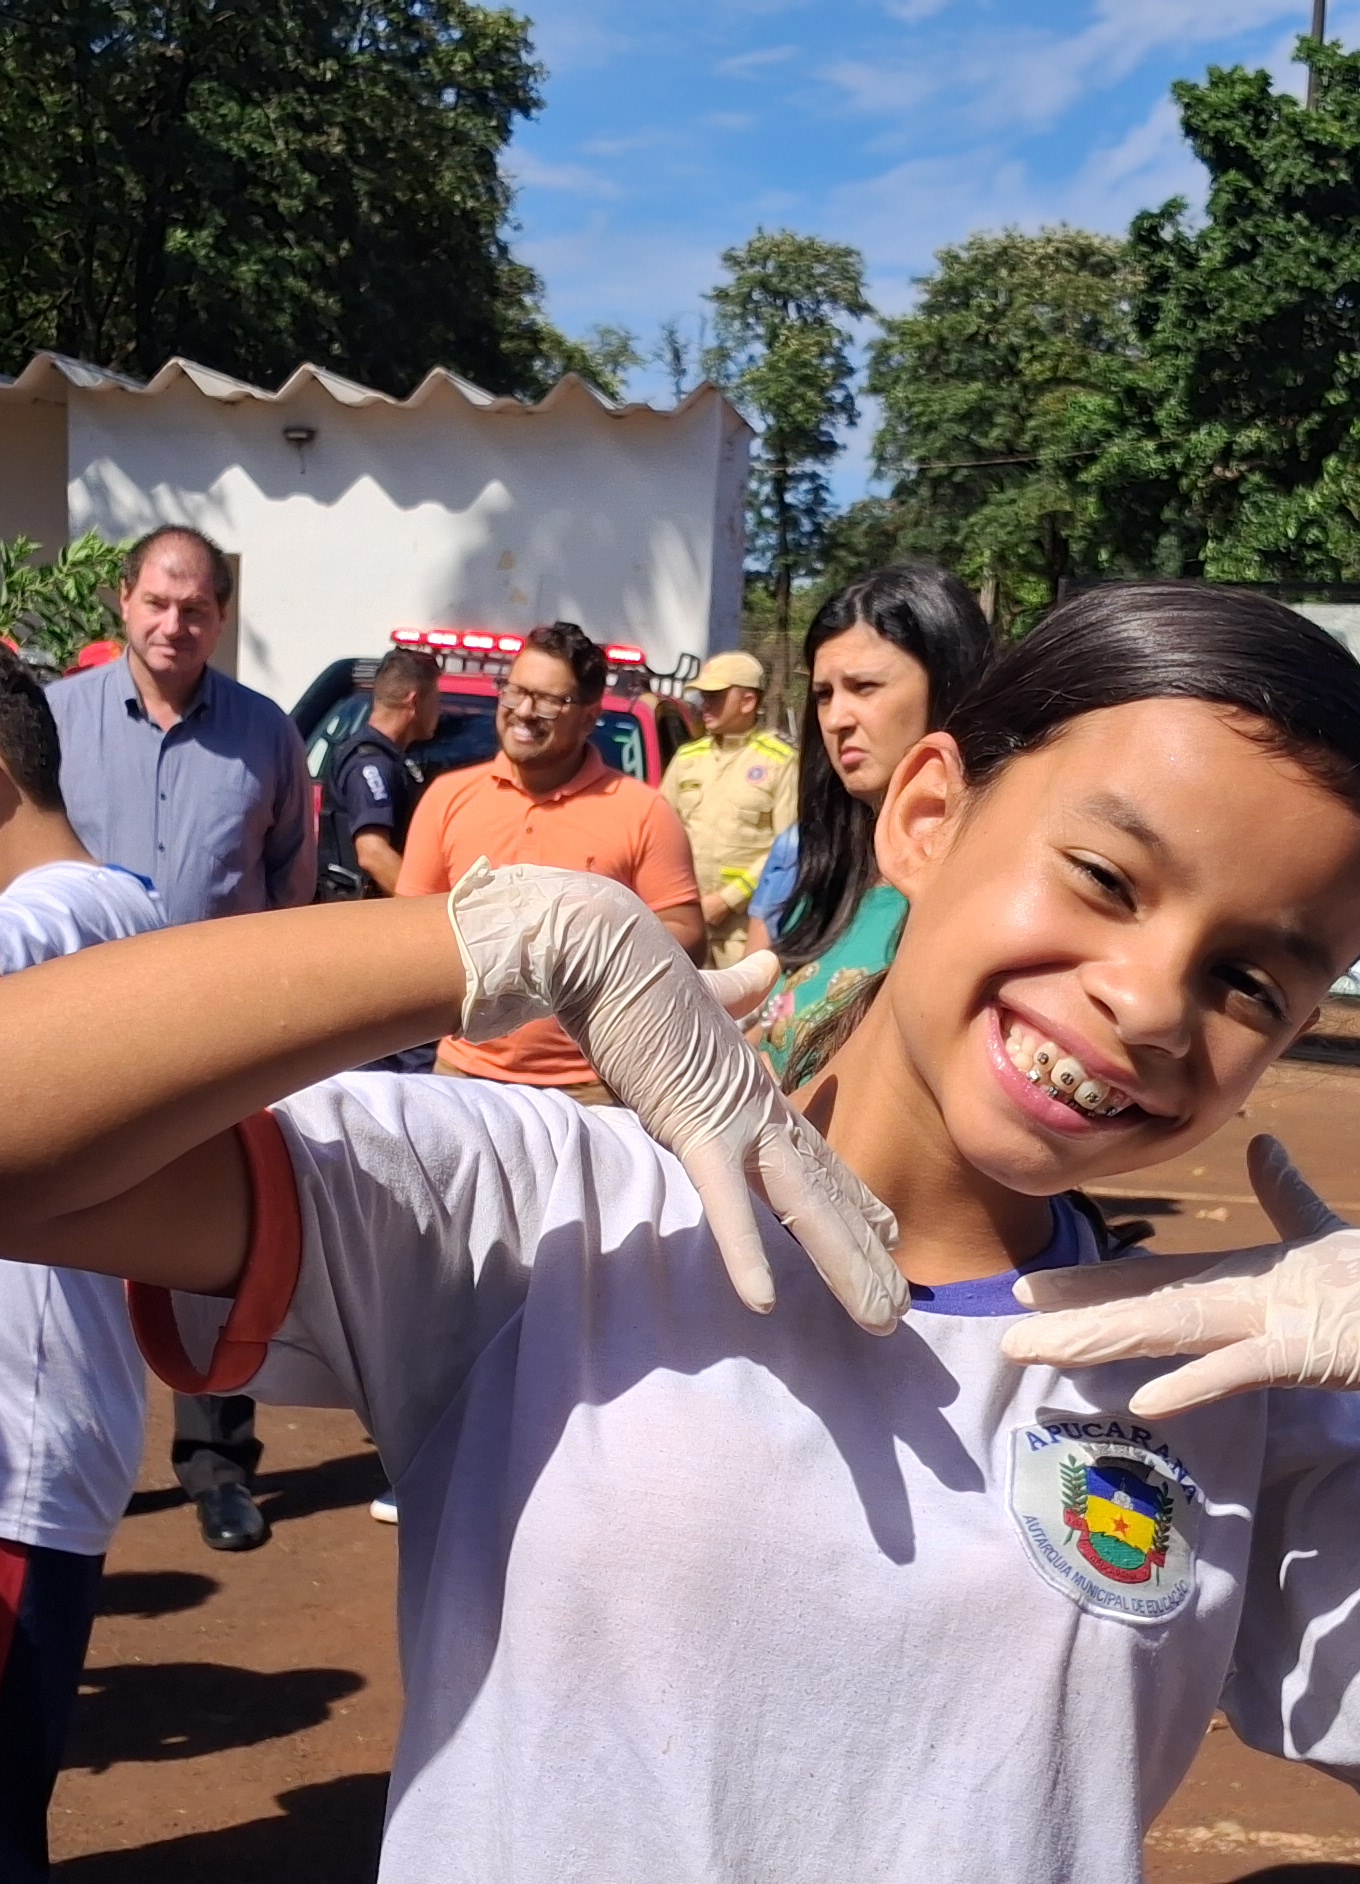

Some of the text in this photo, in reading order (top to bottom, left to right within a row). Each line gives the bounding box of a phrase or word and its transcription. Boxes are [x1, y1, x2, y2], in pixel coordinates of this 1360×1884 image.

[1025, 1421, 1197, 1505] APUCARANA
[1023, 1514, 1073, 1578] AUTARQUIA
[1070, 1571, 1130, 1611] MUNICIPAL
[1131, 1597, 1146, 1614] DE
